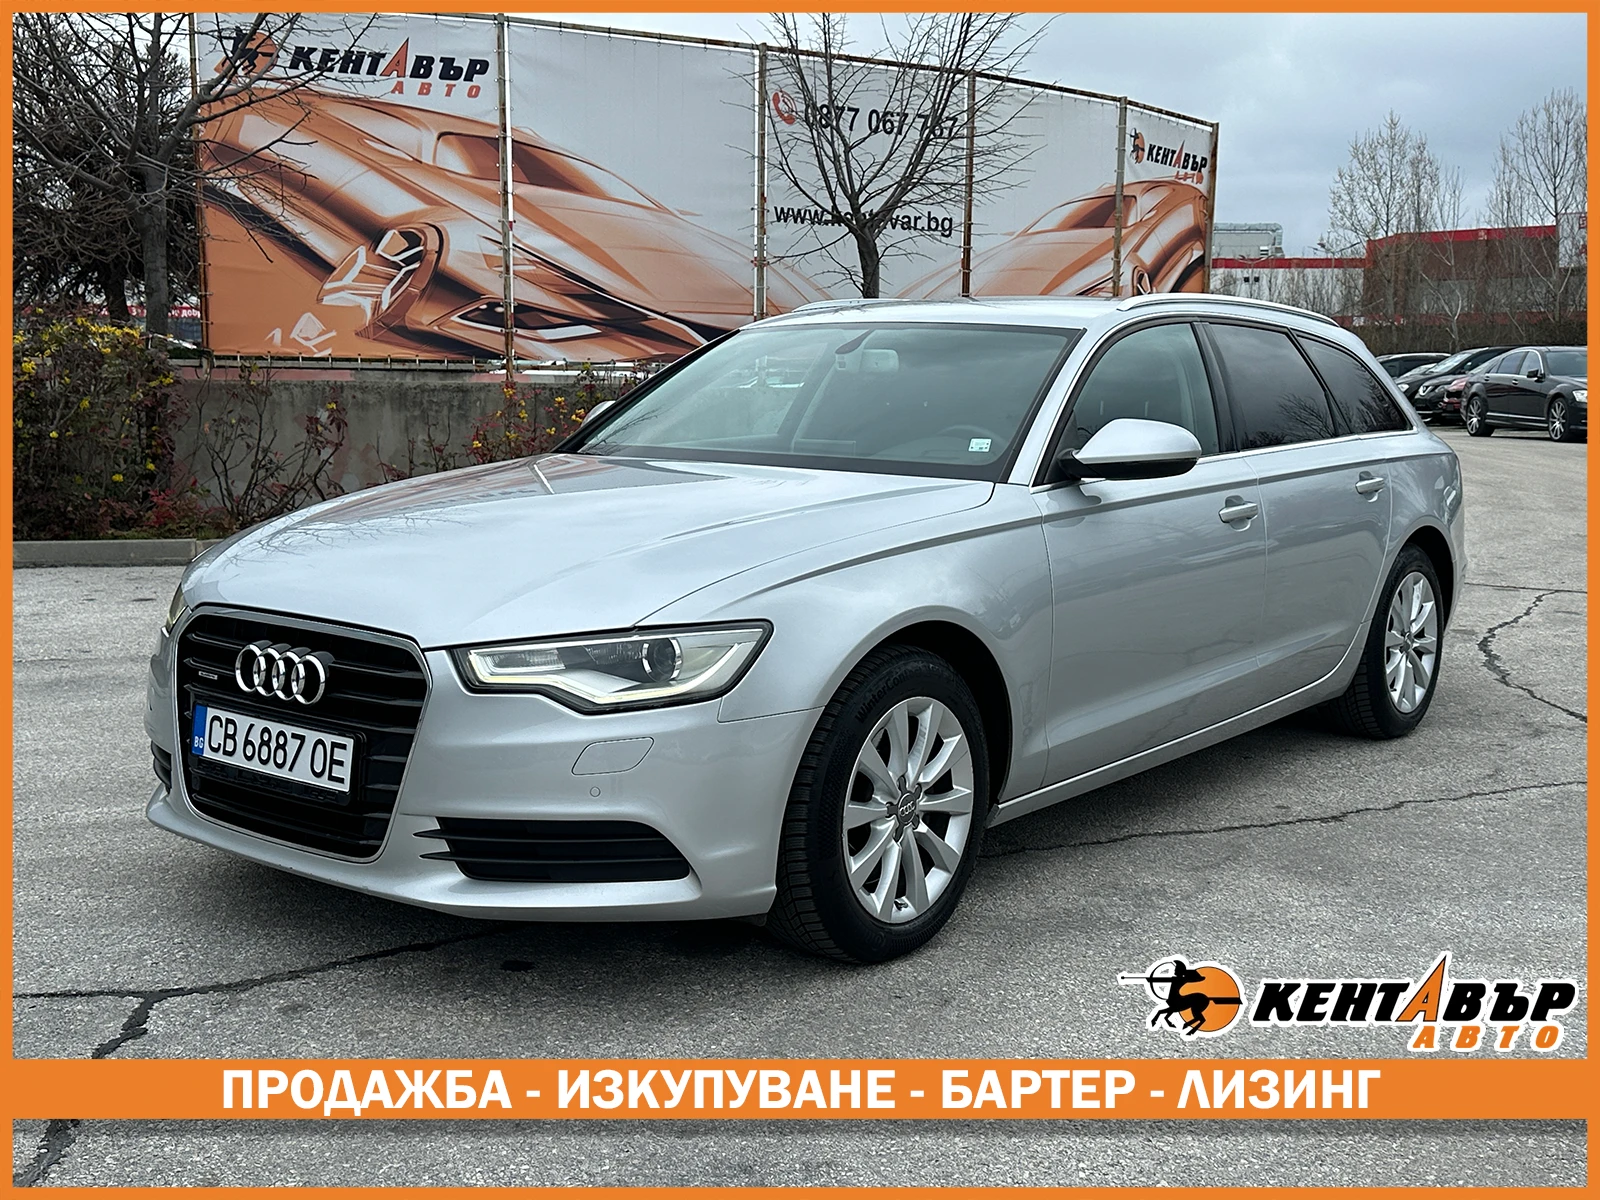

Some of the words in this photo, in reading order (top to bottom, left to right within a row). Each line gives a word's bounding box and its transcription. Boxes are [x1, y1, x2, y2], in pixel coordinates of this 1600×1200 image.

[288, 37, 490, 82] КЕНТАВЪР
[390, 81, 482, 98] АВТО
[867, 108, 909, 136] 067
[1146, 139, 1208, 173] КЕНТАВЪР
[193, 736, 205, 749] BG
[208, 714, 238, 757] CB
[242, 723, 307, 772] 6887
[309, 738, 348, 784] OE
